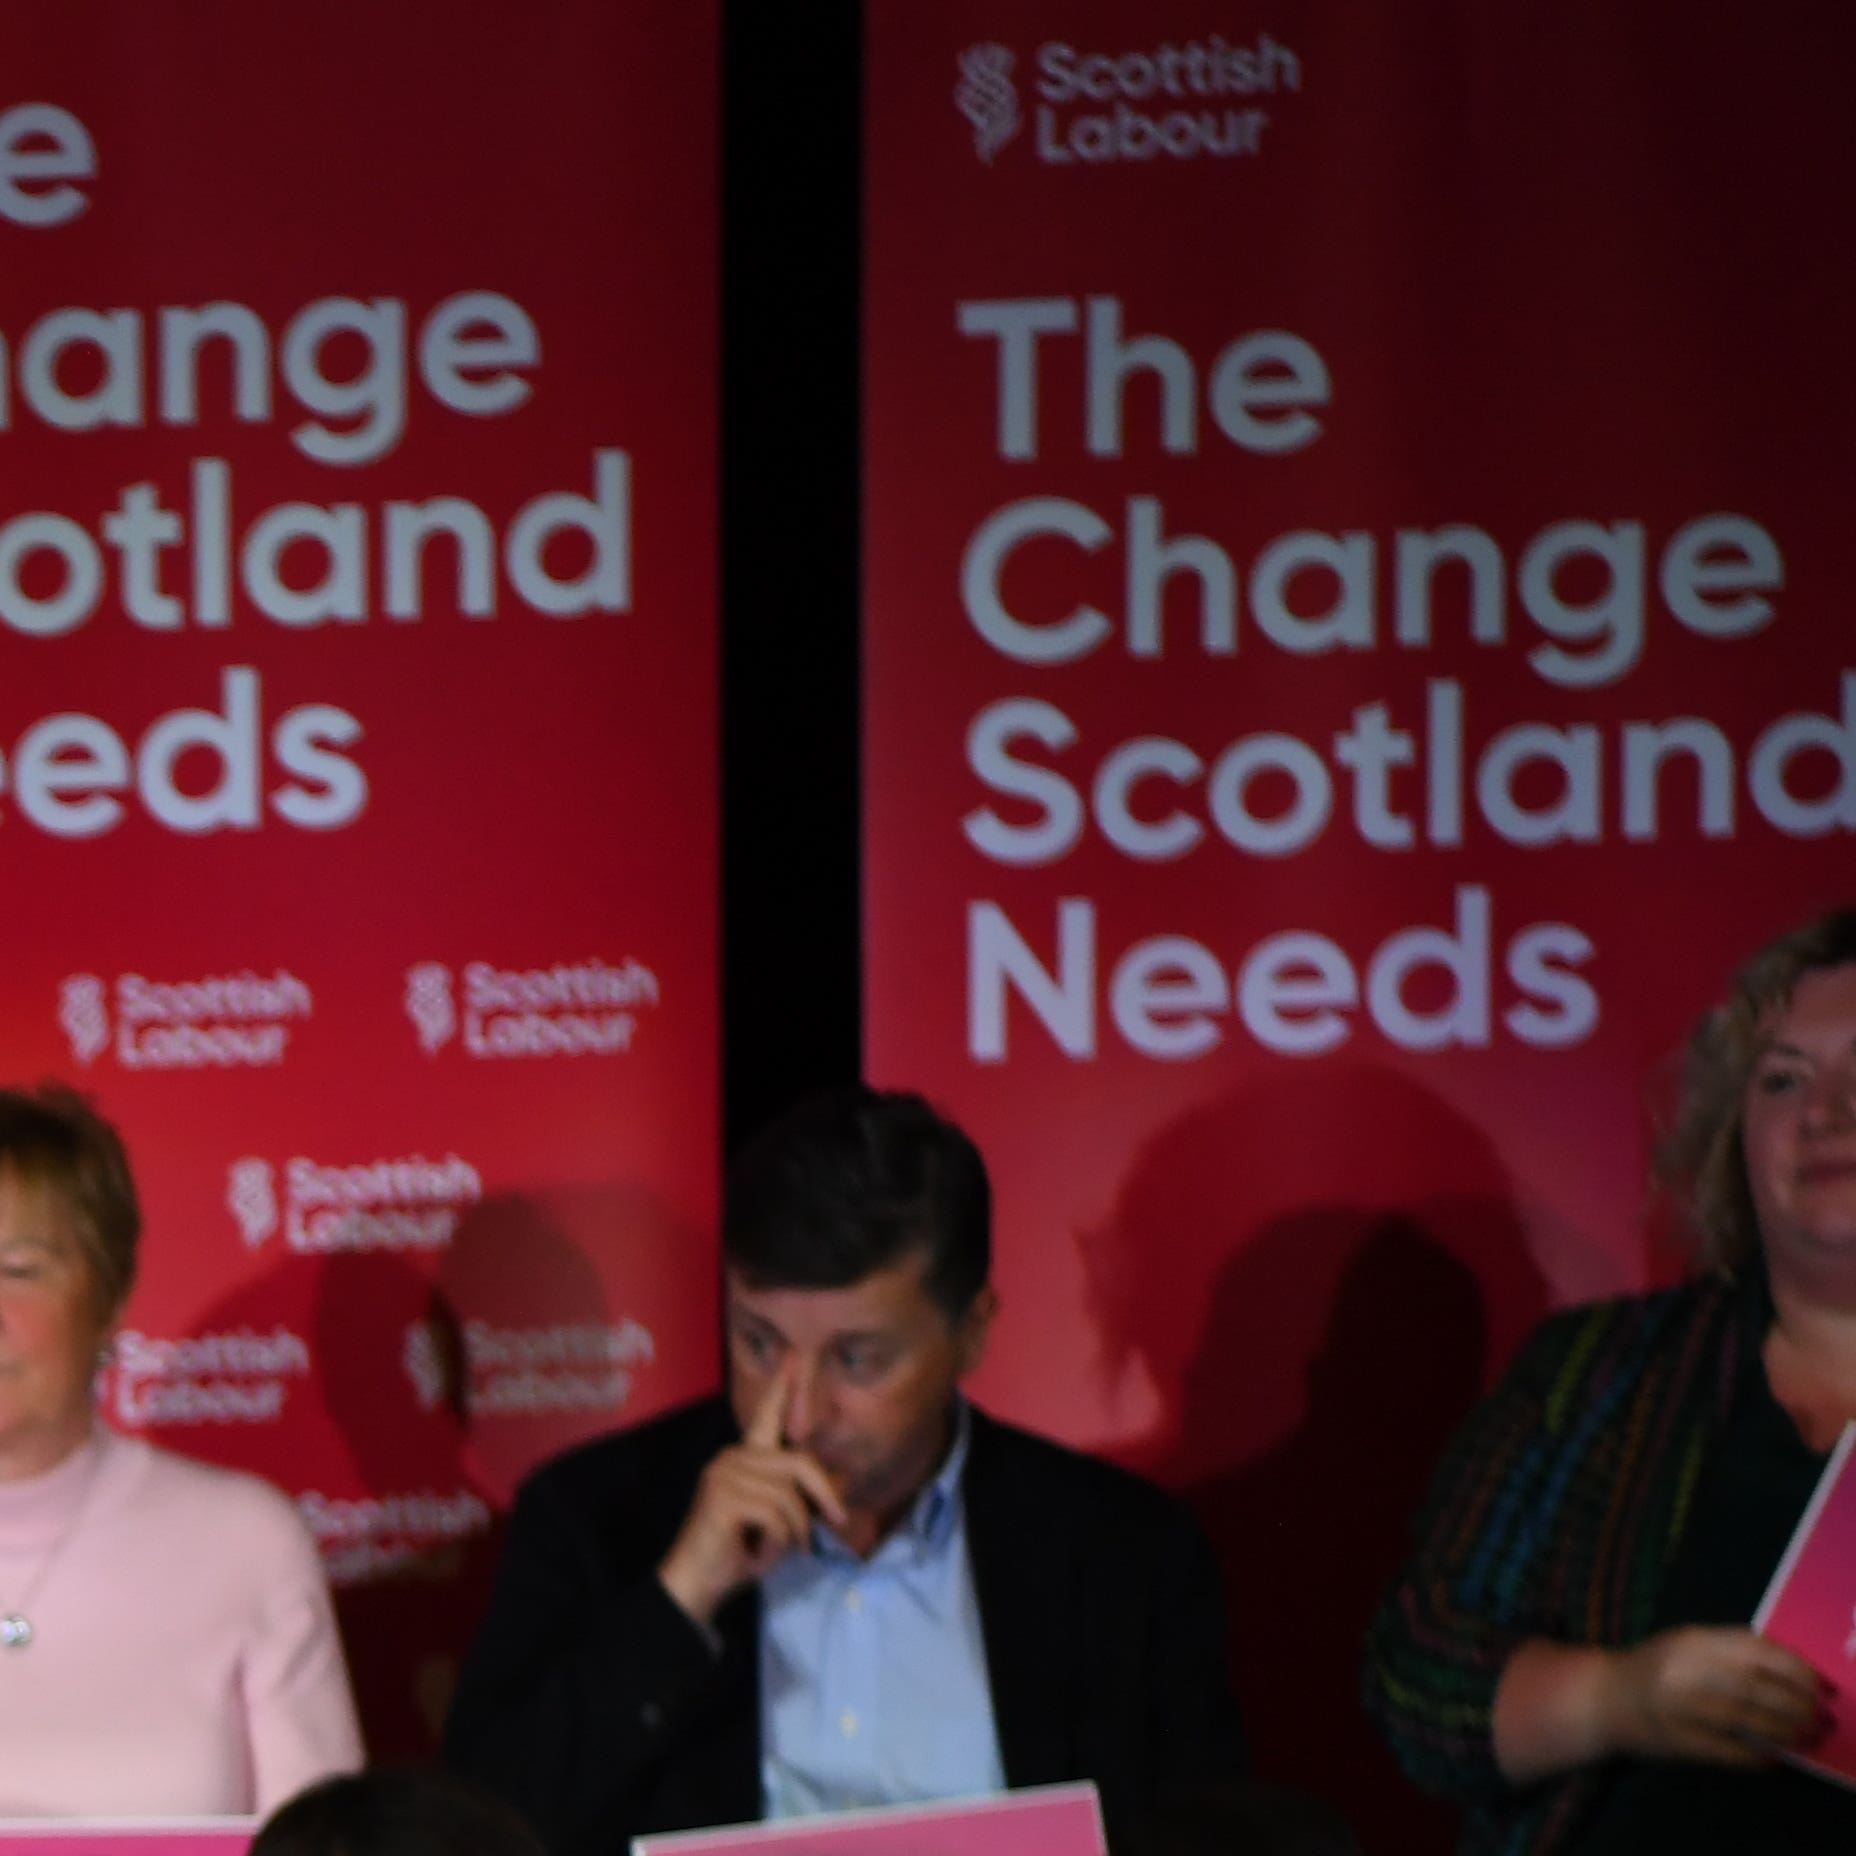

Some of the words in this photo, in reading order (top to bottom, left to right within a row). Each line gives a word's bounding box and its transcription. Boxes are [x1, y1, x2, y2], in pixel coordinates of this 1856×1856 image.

[1037, 36, 1301, 102] Scottish
[1037, 105, 1269, 165] Labour
[957, 295, 1332, 461] The
[960, 496, 1785, 688] Change
[962, 669, 1856, 865] Scotland
[116, 971, 312, 1020] Scottish
[464, 960, 659, 1007] Scottish
[967, 886, 1600, 1064] Needs
[116, 1022, 287, 1068] Labour
[464, 1010, 636, 1058] Labour
[286, 1154, 481, 1202] Scottish
[286, 1205, 457, 1254] Labour
[117, 1328, 309, 1377] Scottish
[117, 1379, 286, 1425] Labour
